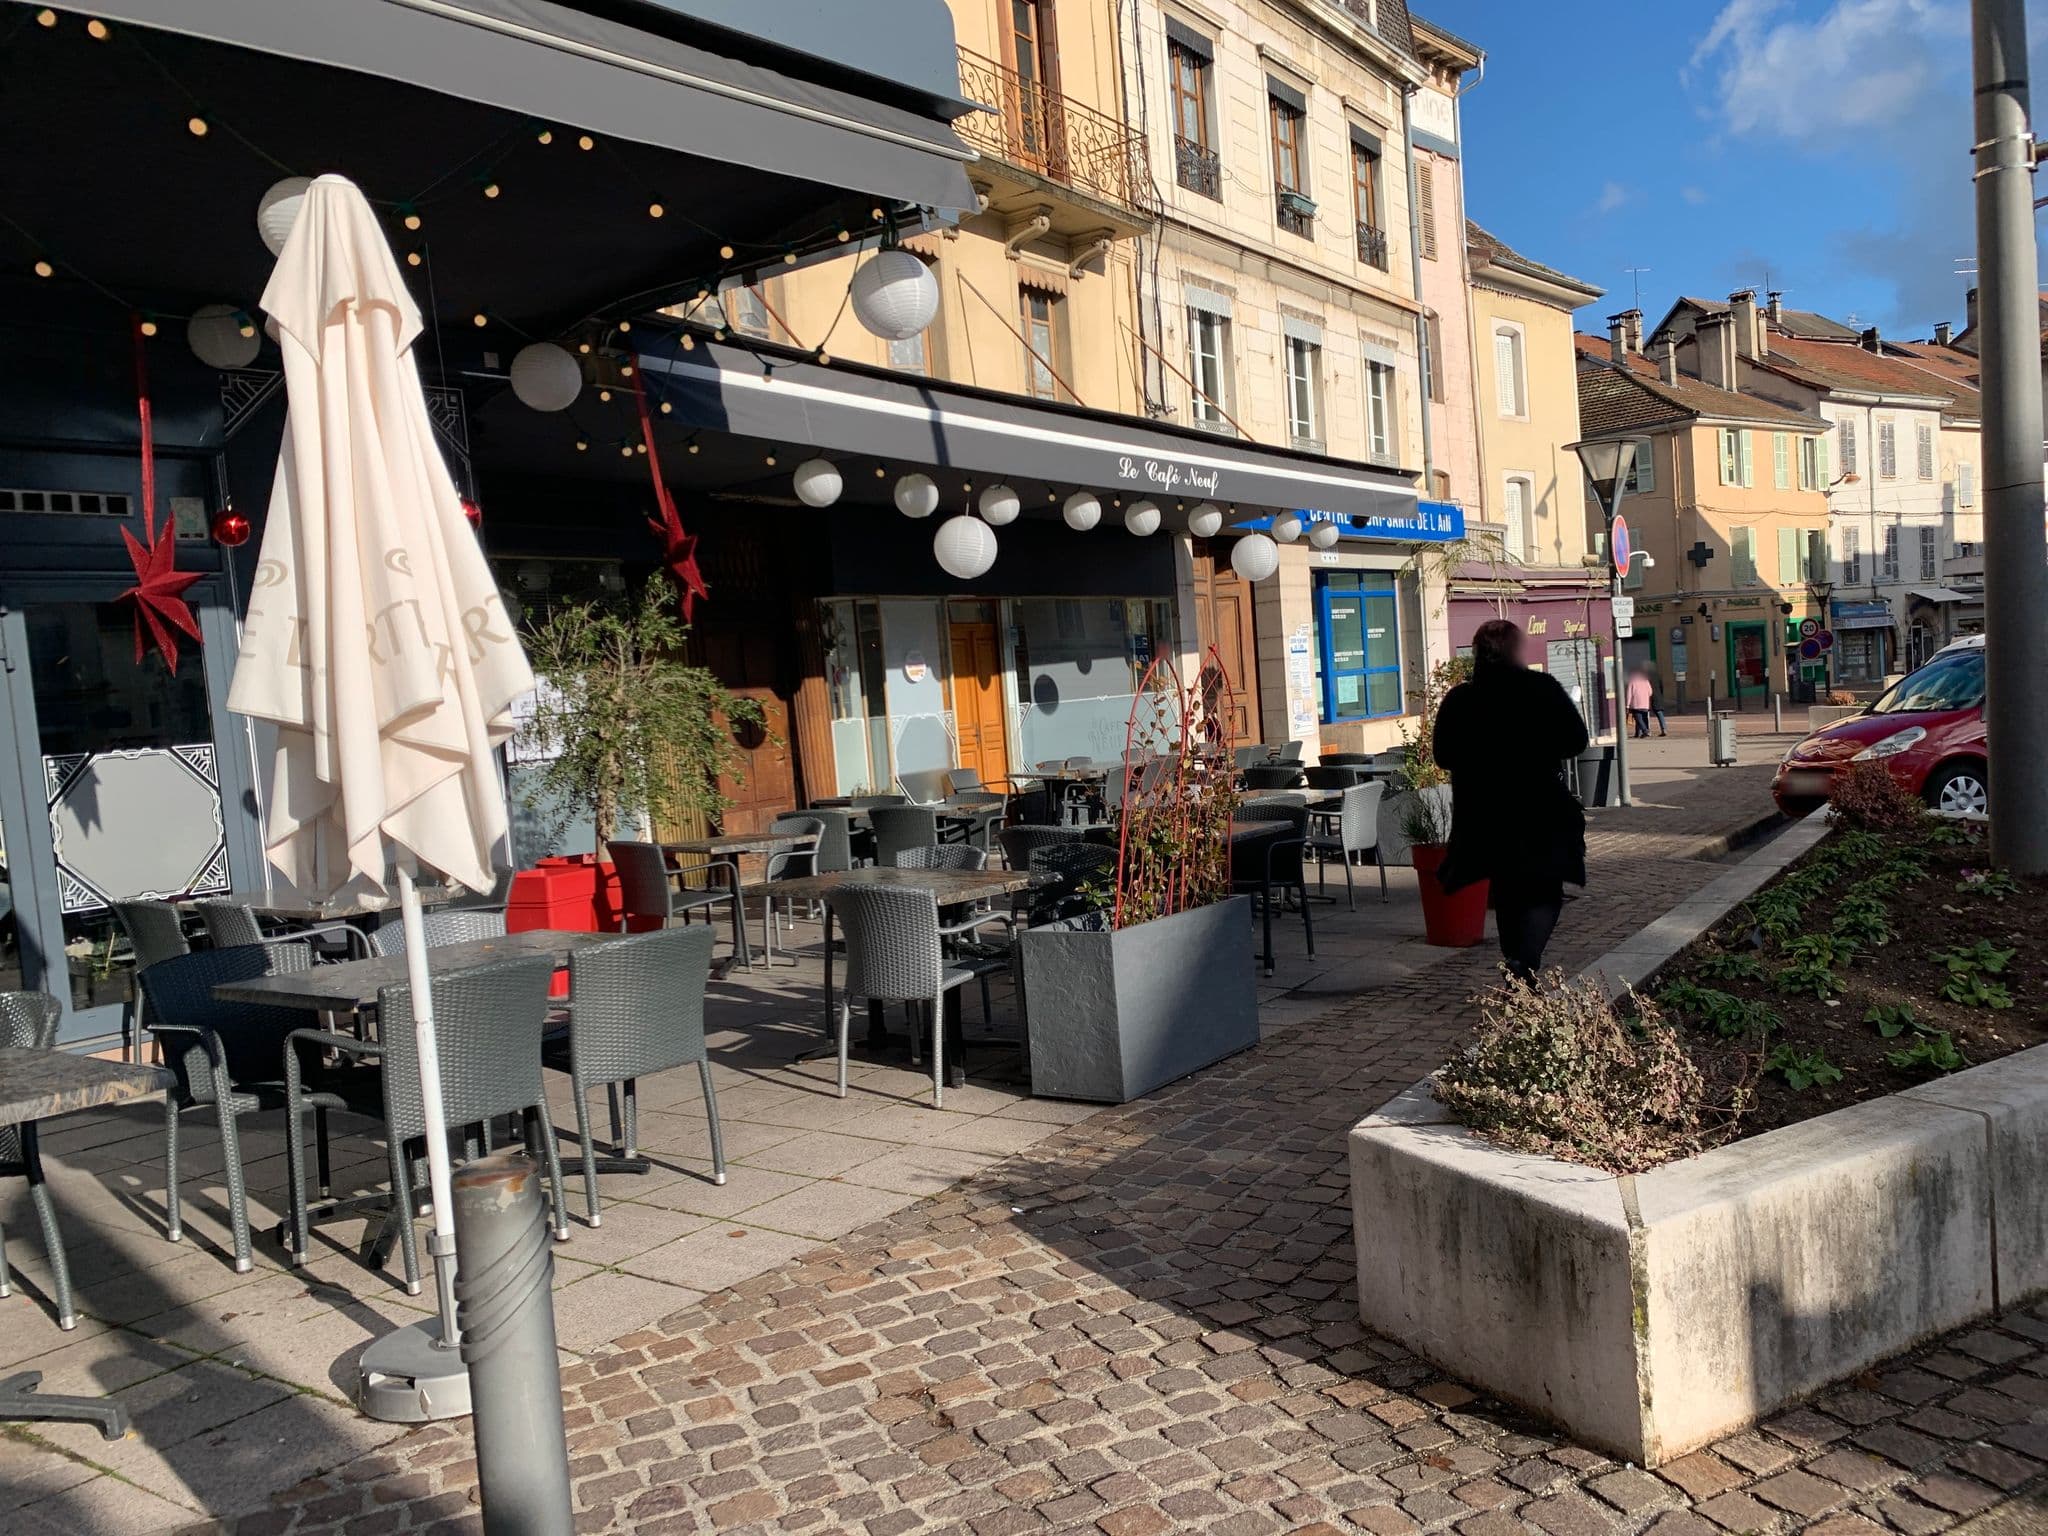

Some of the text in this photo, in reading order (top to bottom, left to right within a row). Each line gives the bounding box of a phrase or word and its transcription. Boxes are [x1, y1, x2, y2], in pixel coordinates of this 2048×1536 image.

[1118, 456, 1219, 496] Le Café Neuf
[1417, 512, 1428, 531] DE
[1804, 624, 1815, 632] 20
